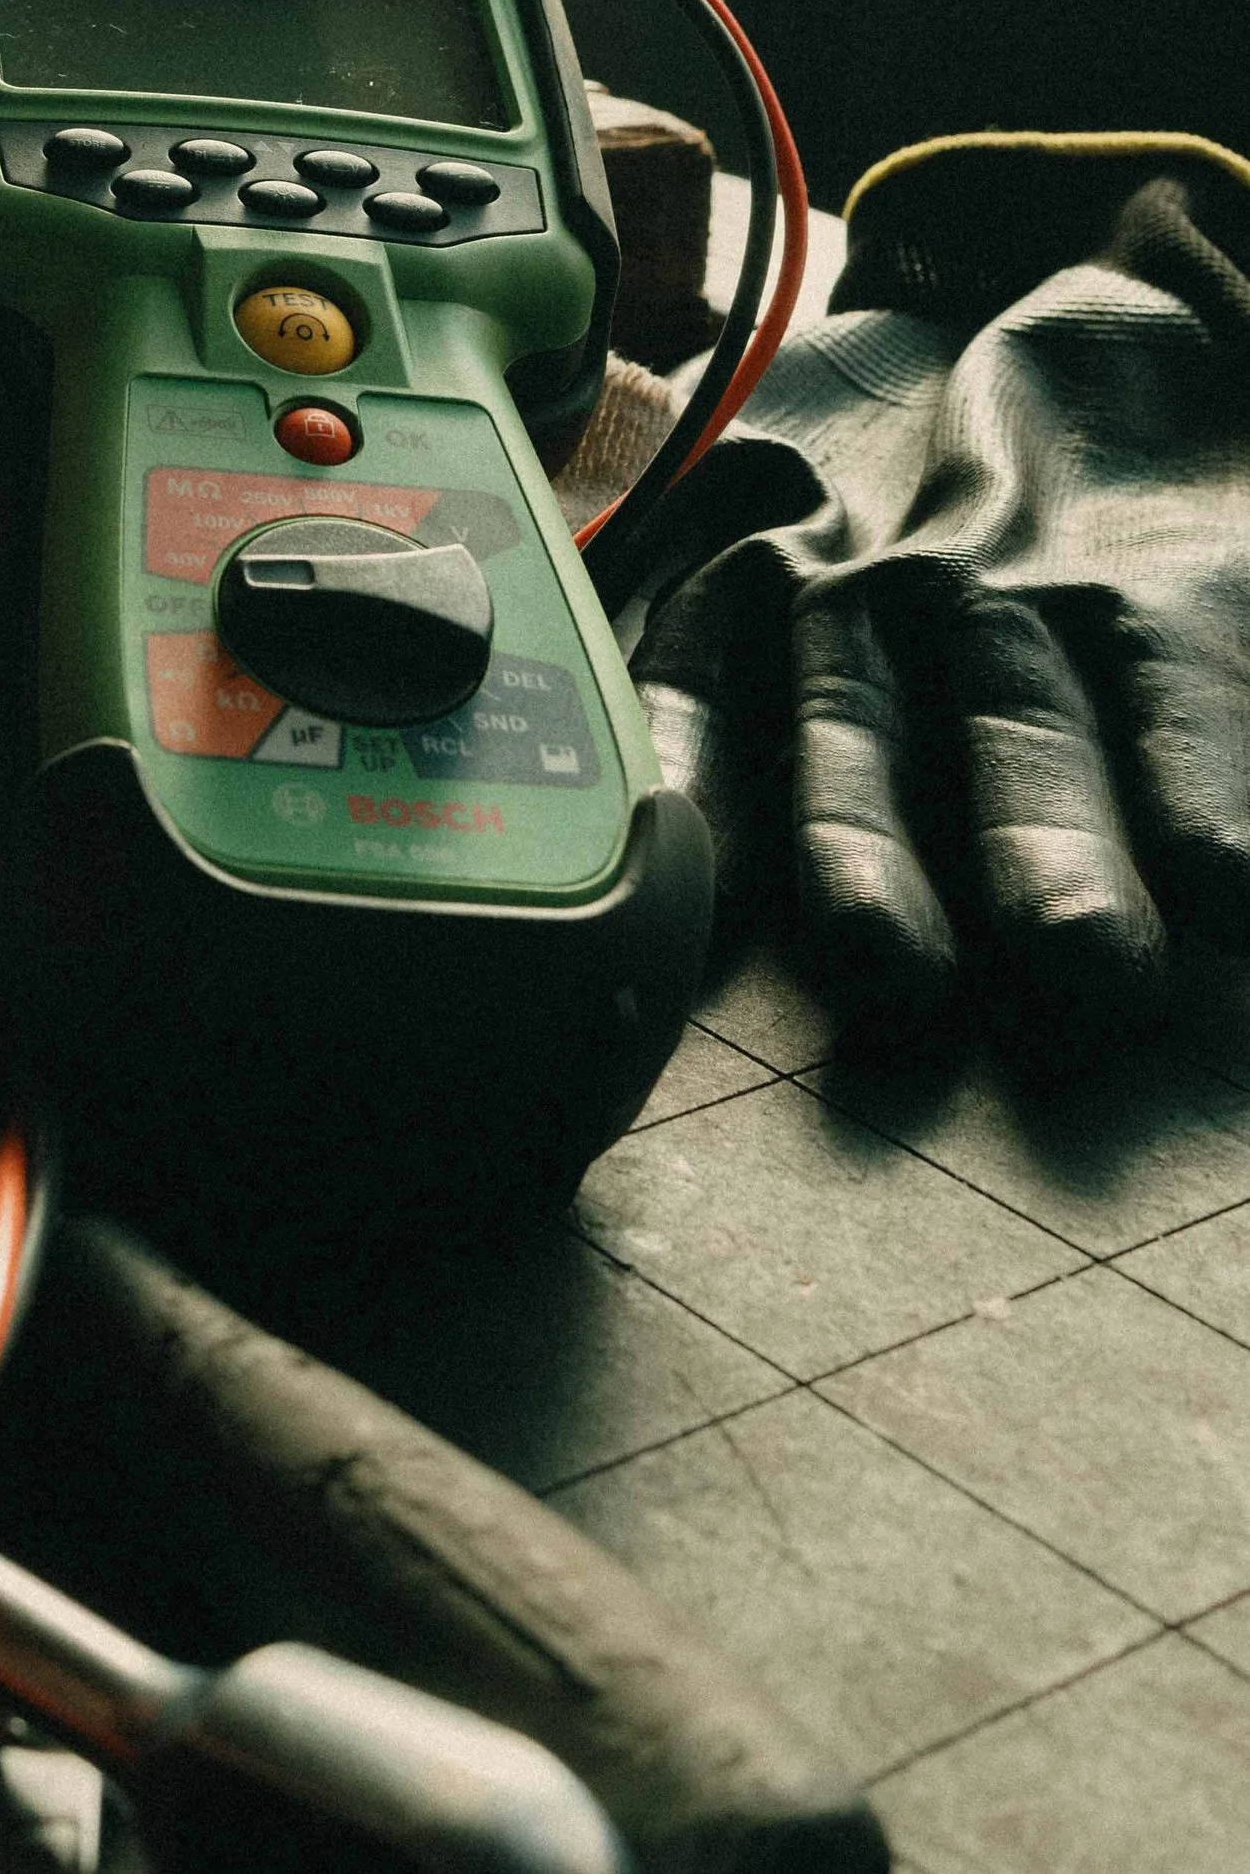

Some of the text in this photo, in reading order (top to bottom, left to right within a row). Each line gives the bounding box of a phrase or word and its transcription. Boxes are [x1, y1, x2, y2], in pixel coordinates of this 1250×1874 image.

[261, 292, 331, 311] TEST
[384, 428, 432, 450] OK
[448, 524, 470, 544] V
[144, 594, 208, 616] OFF
[501, 669, 551, 691] DEL
[472, 711, 528, 734] SND
[421, 733, 474, 758] RCL
[346, 793, 507, 835] BOSCH
